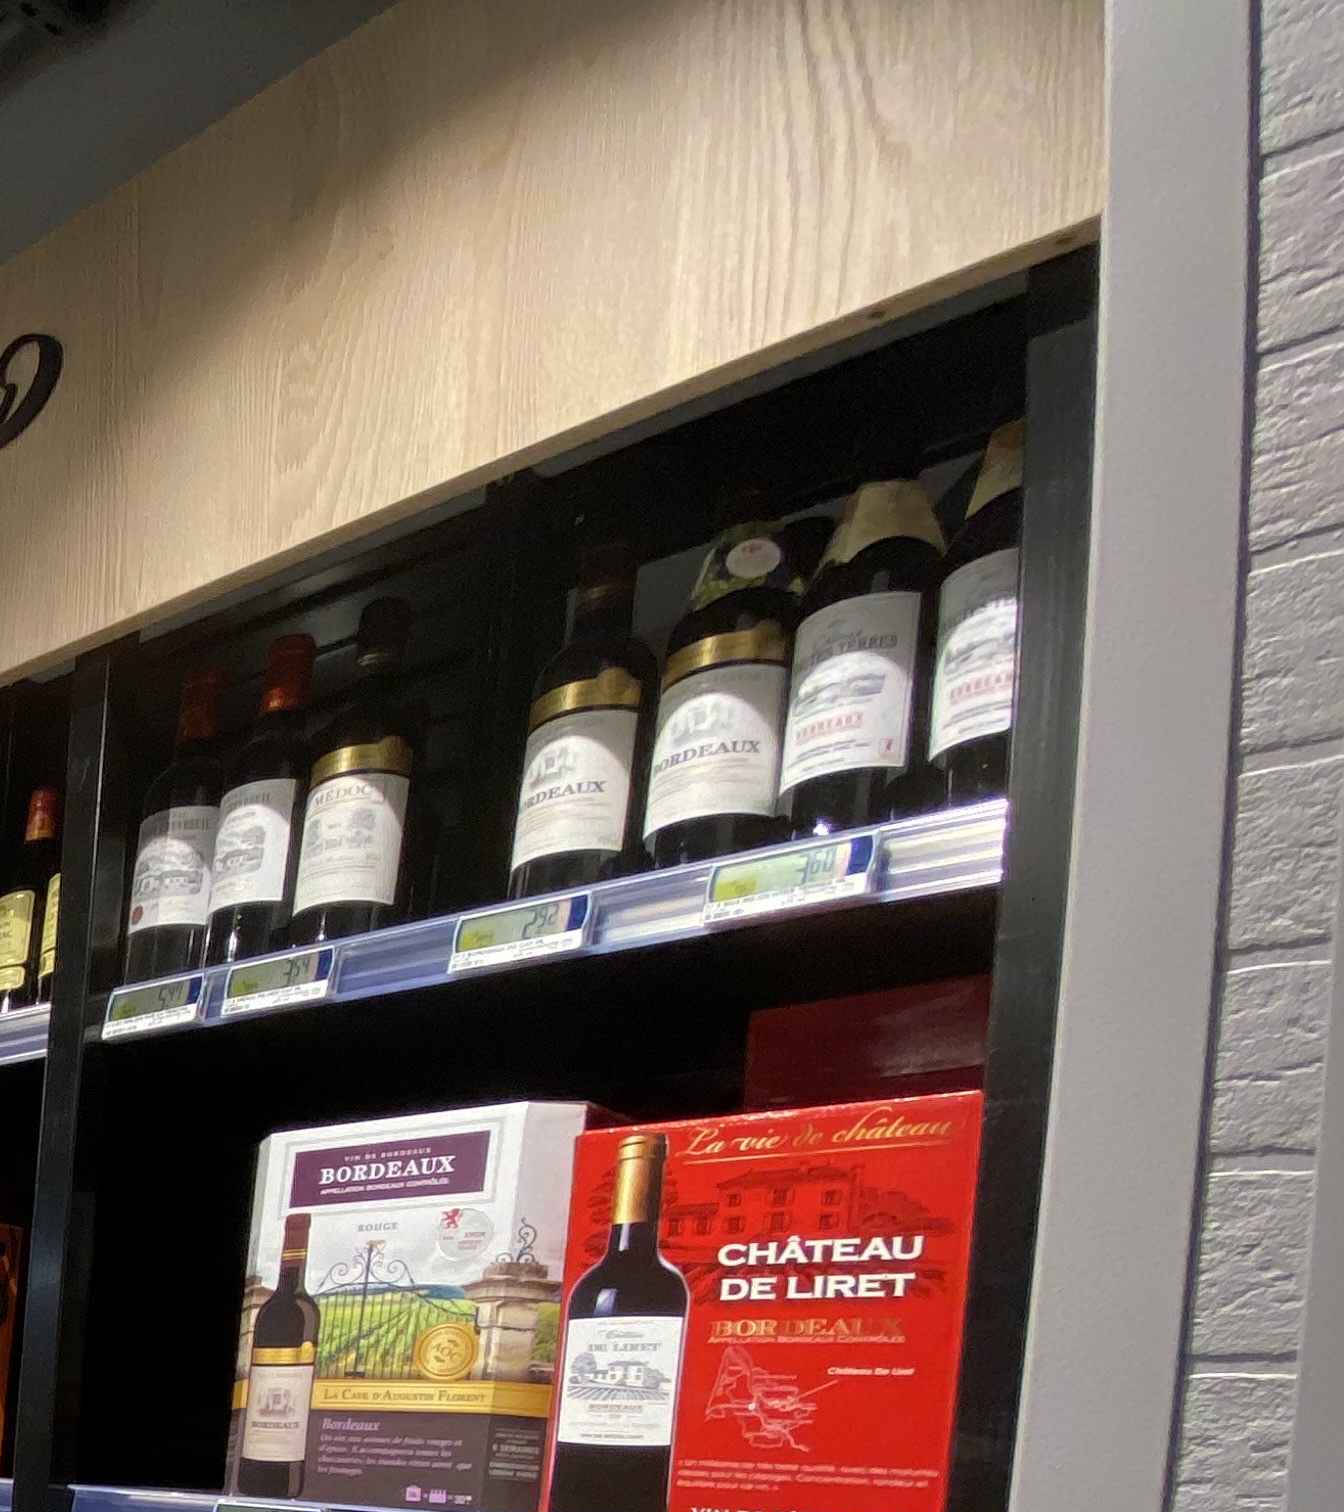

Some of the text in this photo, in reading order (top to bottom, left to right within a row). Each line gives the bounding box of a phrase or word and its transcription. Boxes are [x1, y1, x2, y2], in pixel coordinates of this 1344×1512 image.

[319, 1155, 456, 1186] BORDEAUX
[717, 1235, 924, 1267] CHÂTEAU
[720, 1272, 916, 1301] DE LIRET
[711, 1317, 904, 1337] BORDEAUX
[322, 1418, 381, 1431] Bordeaux
